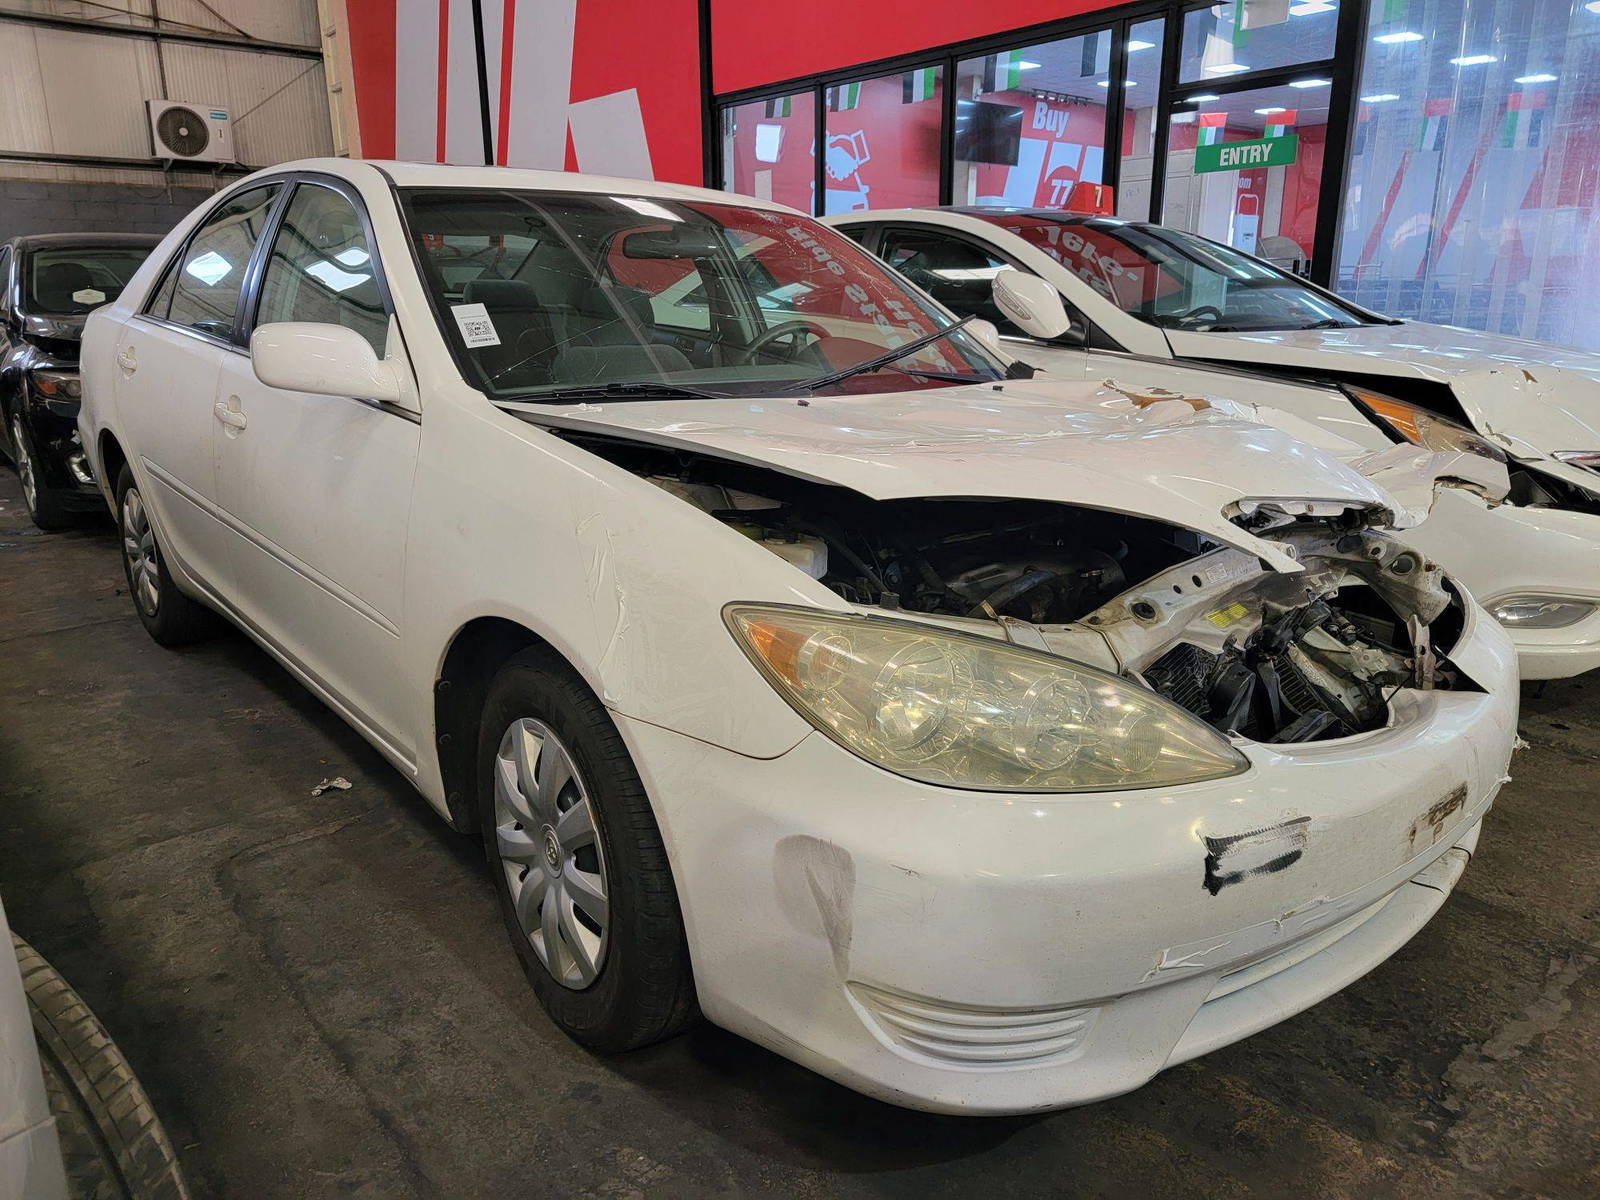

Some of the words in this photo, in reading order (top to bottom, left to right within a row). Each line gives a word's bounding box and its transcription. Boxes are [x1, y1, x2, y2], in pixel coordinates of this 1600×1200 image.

[1032, 101, 1070, 139] Buy
[1219, 142, 1273, 167] ENTRY
[1050, 179, 1074, 206] 77
